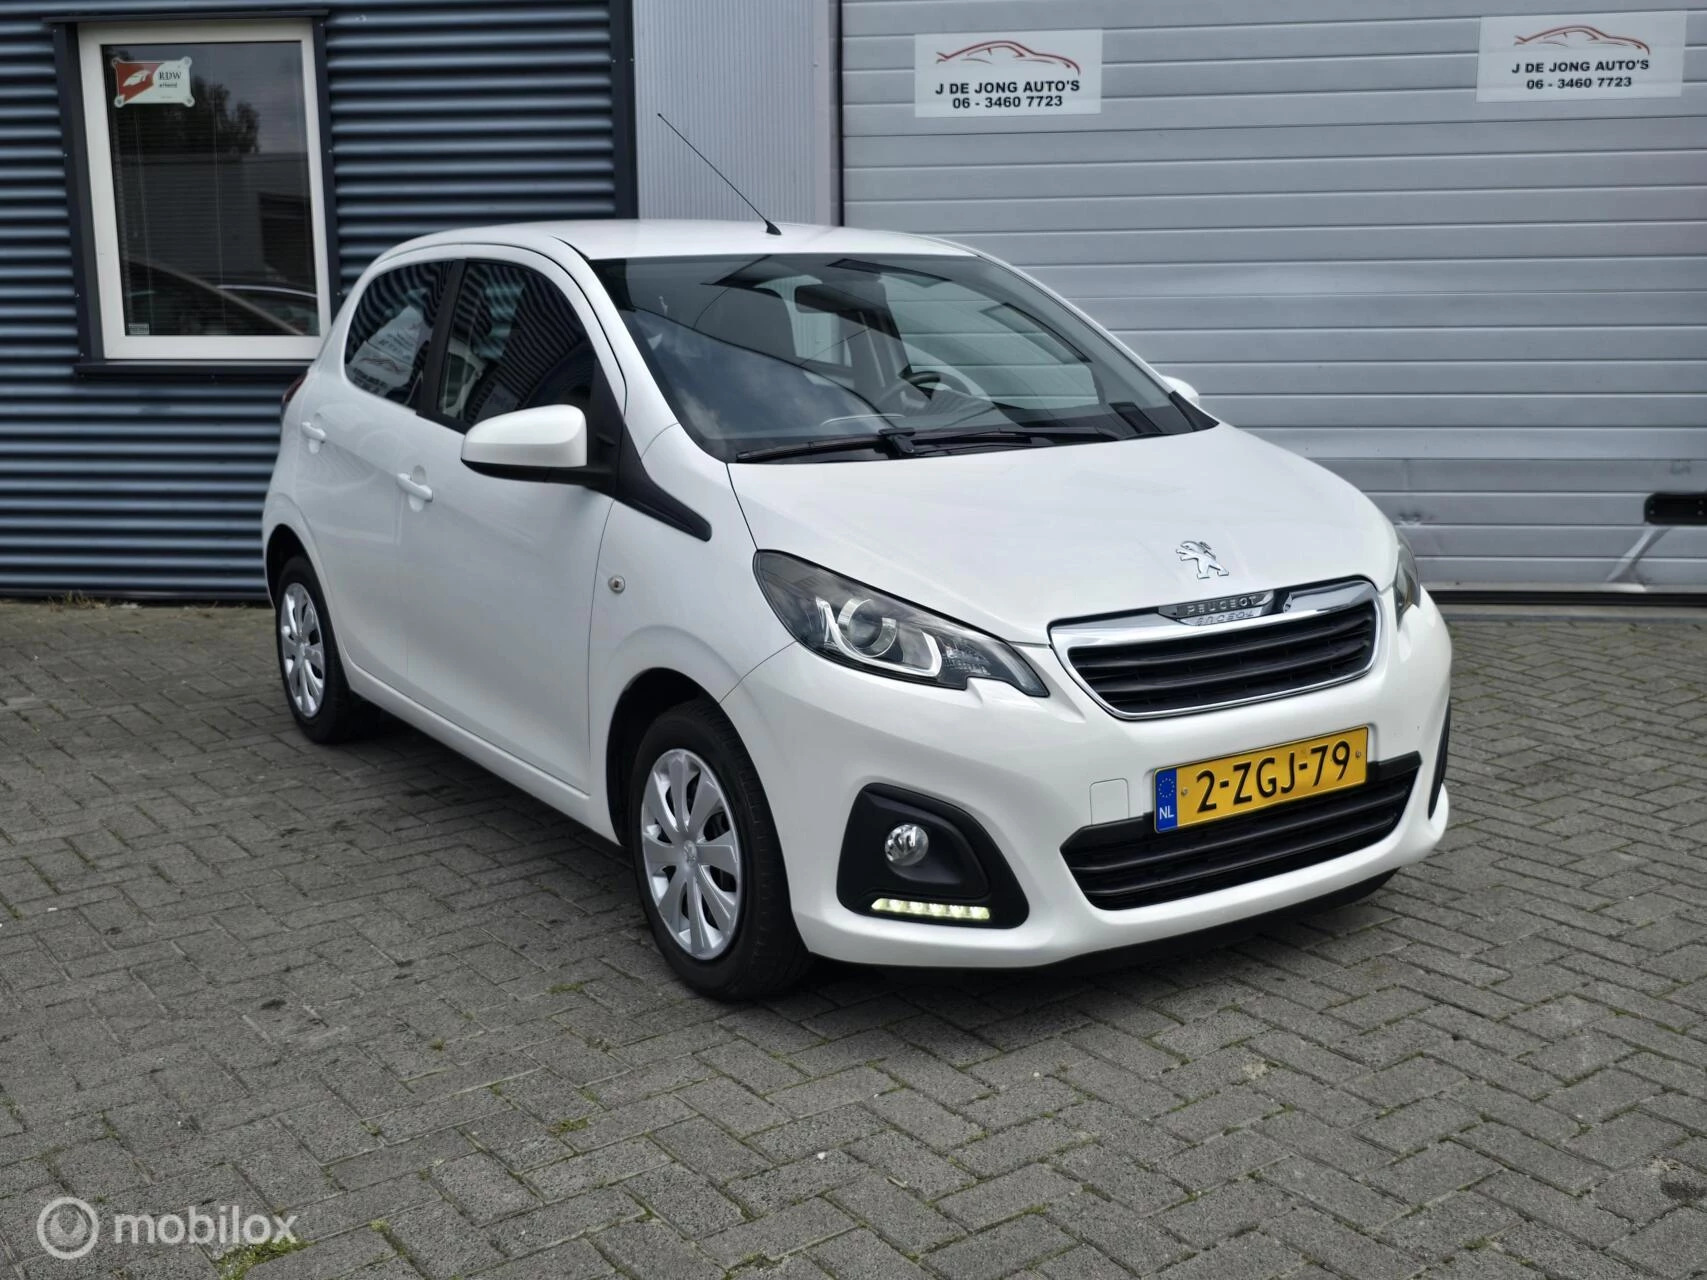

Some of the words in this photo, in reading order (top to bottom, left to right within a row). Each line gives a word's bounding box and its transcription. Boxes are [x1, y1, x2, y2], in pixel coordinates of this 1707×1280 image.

[1511, 63, 1520, 74] J
[1524, 63, 1544, 73] DE
[1549, 61, 1590, 73] JONG
[1595, 59, 1649, 71] AUTO'S
[935, 83, 944, 95] J
[949, 83, 970, 94] DE
[974, 82, 1018, 94] JONG
[1023, 80, 1080, 92] AUTO'S
[1526, 79, 1544, 90] 06
[1557, 78, 1592, 89] 3460
[1597, 77, 1632, 88] 7723
[952, 97, 970, 109] 06
[985, 96, 1021, 108] 3460
[1026, 95, 1063, 107] 7723
[1196, 740, 1351, 813] 2-ZGJ-79
[1159, 806, 1175, 820] NL
